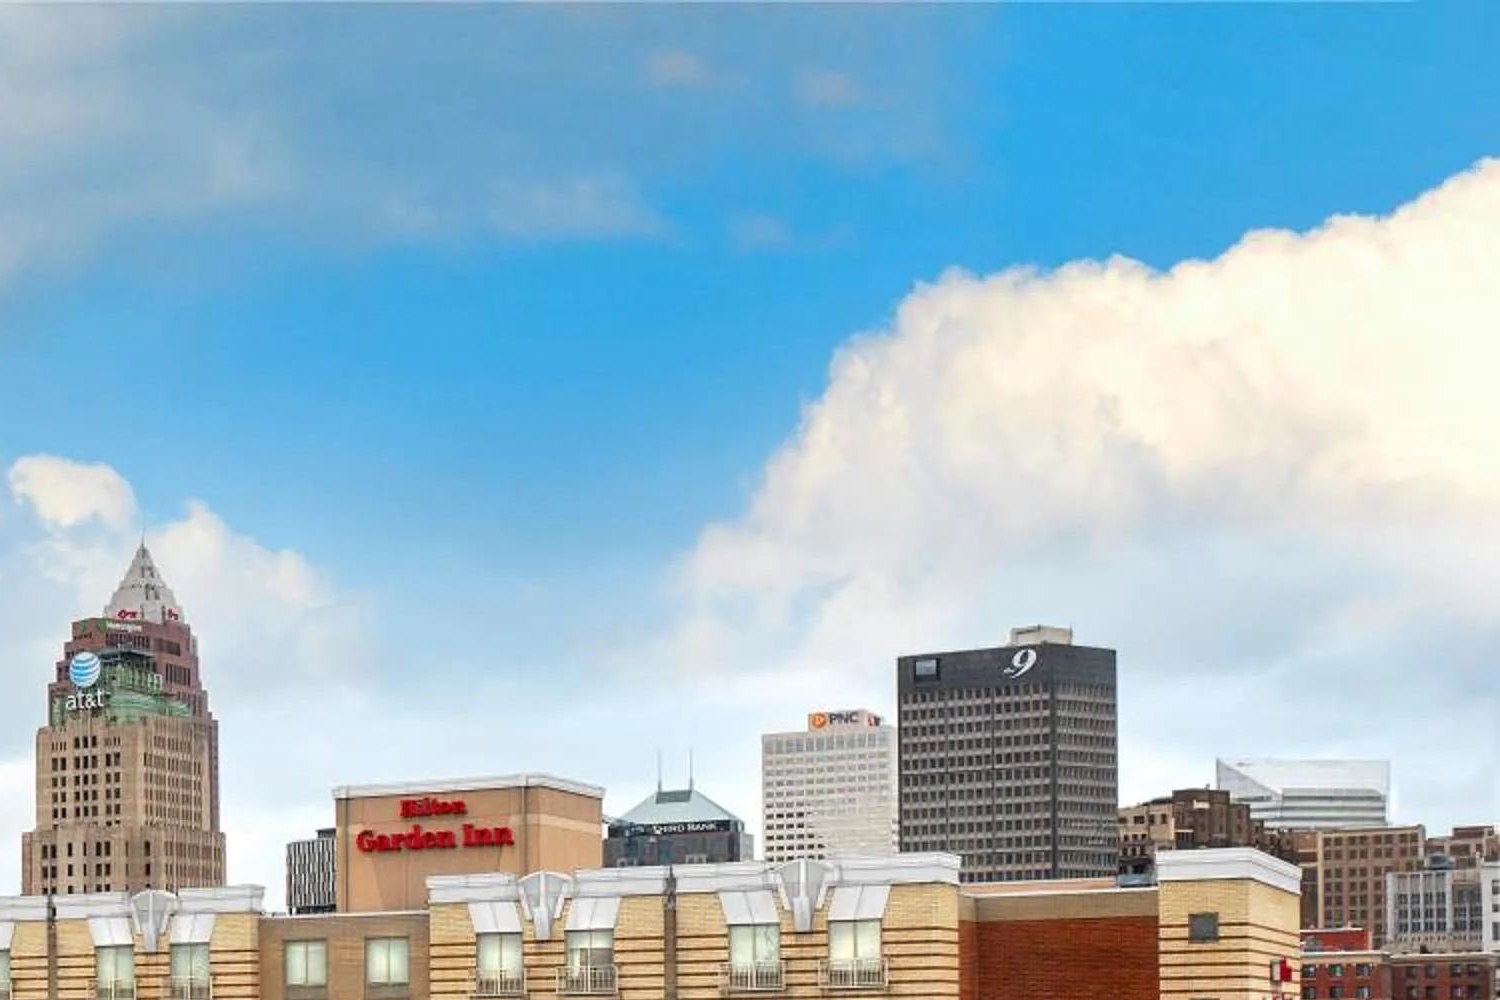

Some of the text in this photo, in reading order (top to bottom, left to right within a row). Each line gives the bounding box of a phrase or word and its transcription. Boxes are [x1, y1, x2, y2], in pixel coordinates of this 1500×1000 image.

[66, 688, 105, 710] at&t
[828, 711, 860, 725] PNC
[400, 798, 467, 817] Hilton
[687, 823, 717, 832] BANK
[356, 823, 514, 852] Garden Inn
